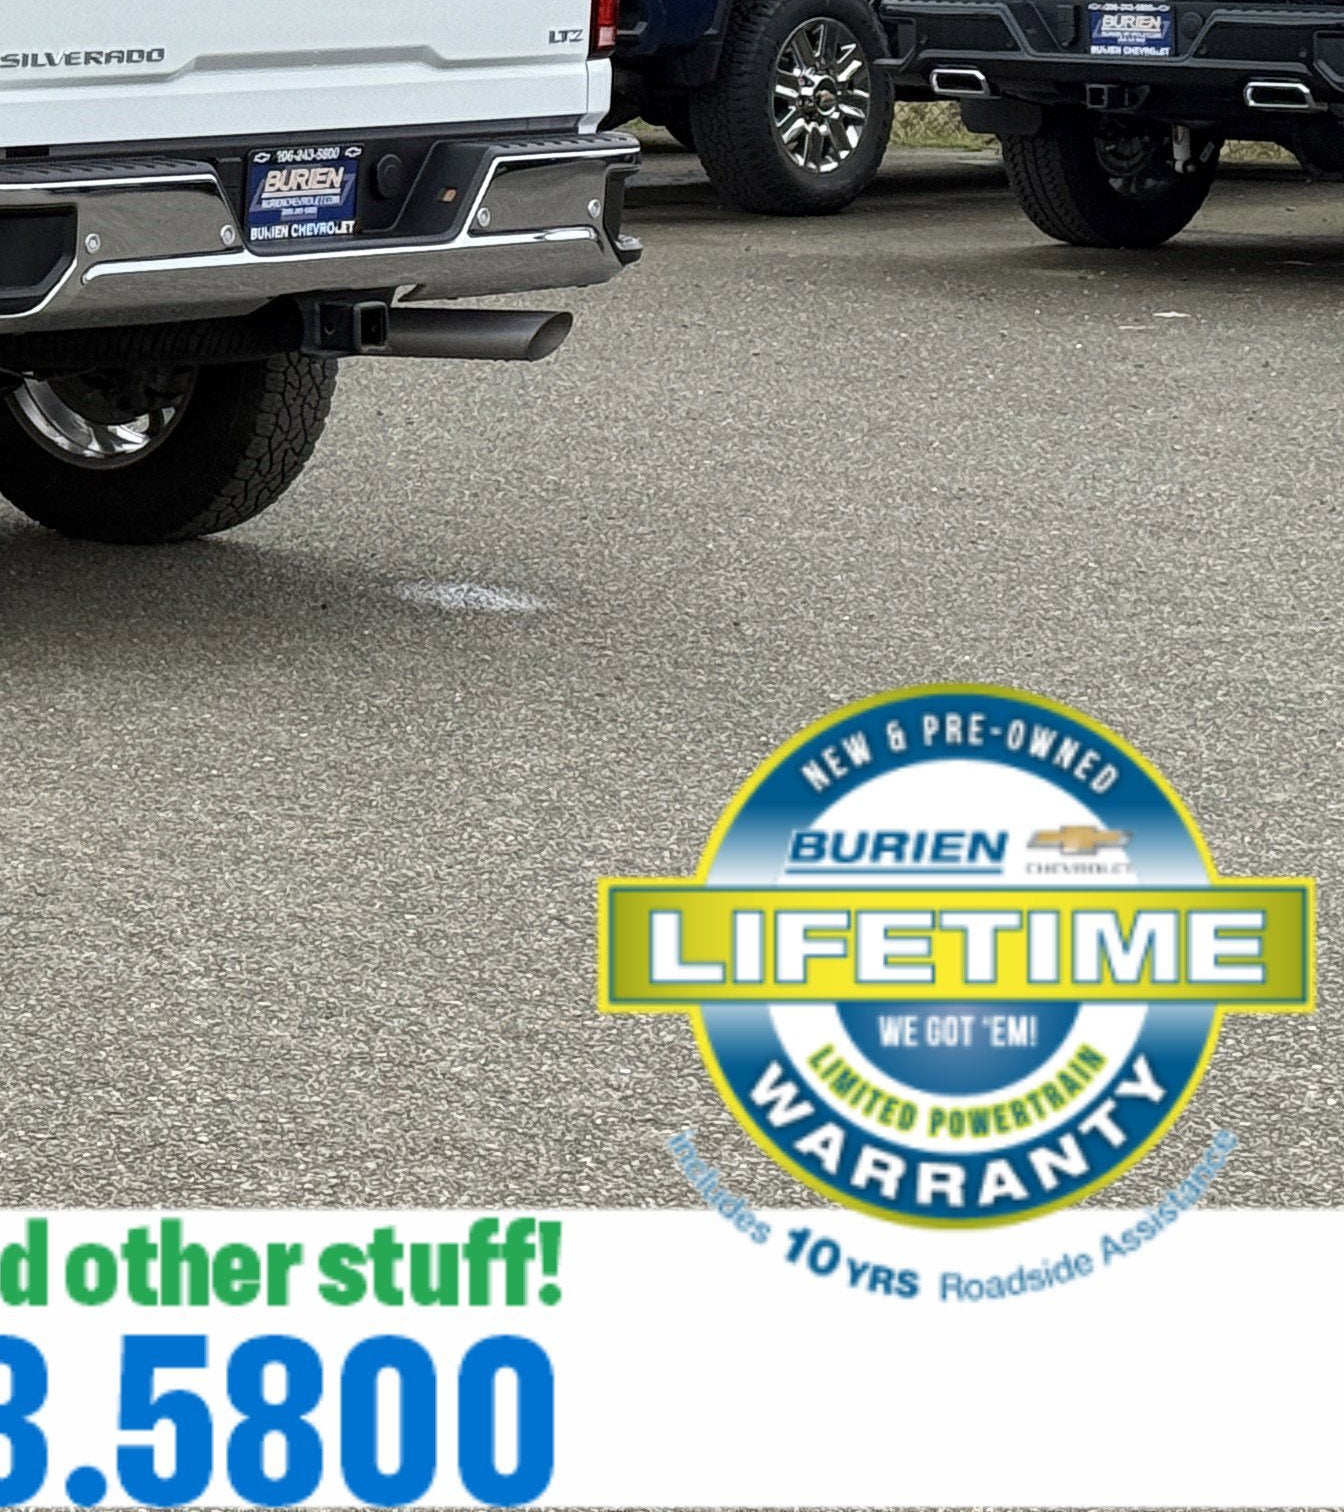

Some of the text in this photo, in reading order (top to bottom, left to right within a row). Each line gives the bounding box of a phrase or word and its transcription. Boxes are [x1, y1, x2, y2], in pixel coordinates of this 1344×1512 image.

[548, 29, 584, 44] LTZ
[0, 48, 165, 69] SILVERADO
[264, 167, 345, 192] BURIEN
[291, 220, 355, 239] CHEVROLET
